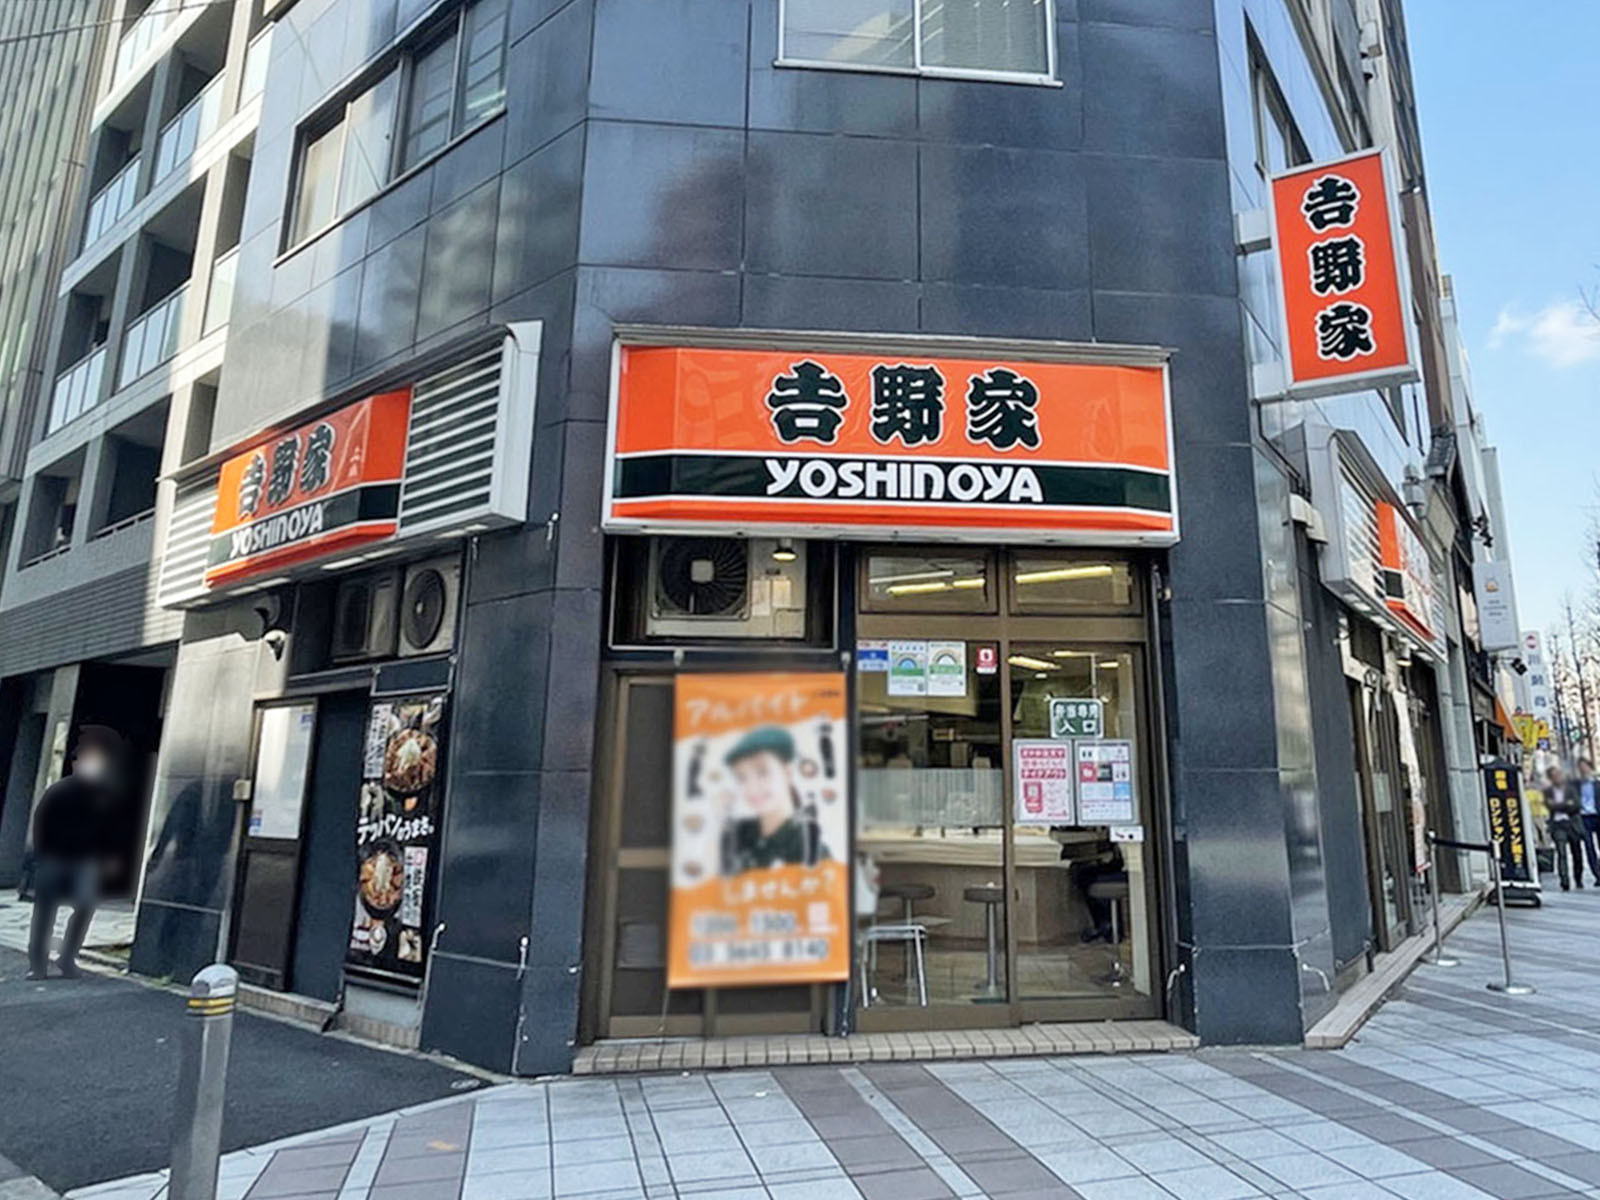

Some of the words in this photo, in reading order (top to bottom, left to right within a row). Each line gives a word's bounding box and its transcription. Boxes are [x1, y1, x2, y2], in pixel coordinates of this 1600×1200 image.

[765, 458, 1044, 503] YOSHINOYA
[230, 502, 324, 559] YOSHINOYA
[1059, 719, 1097, 733] 入口
